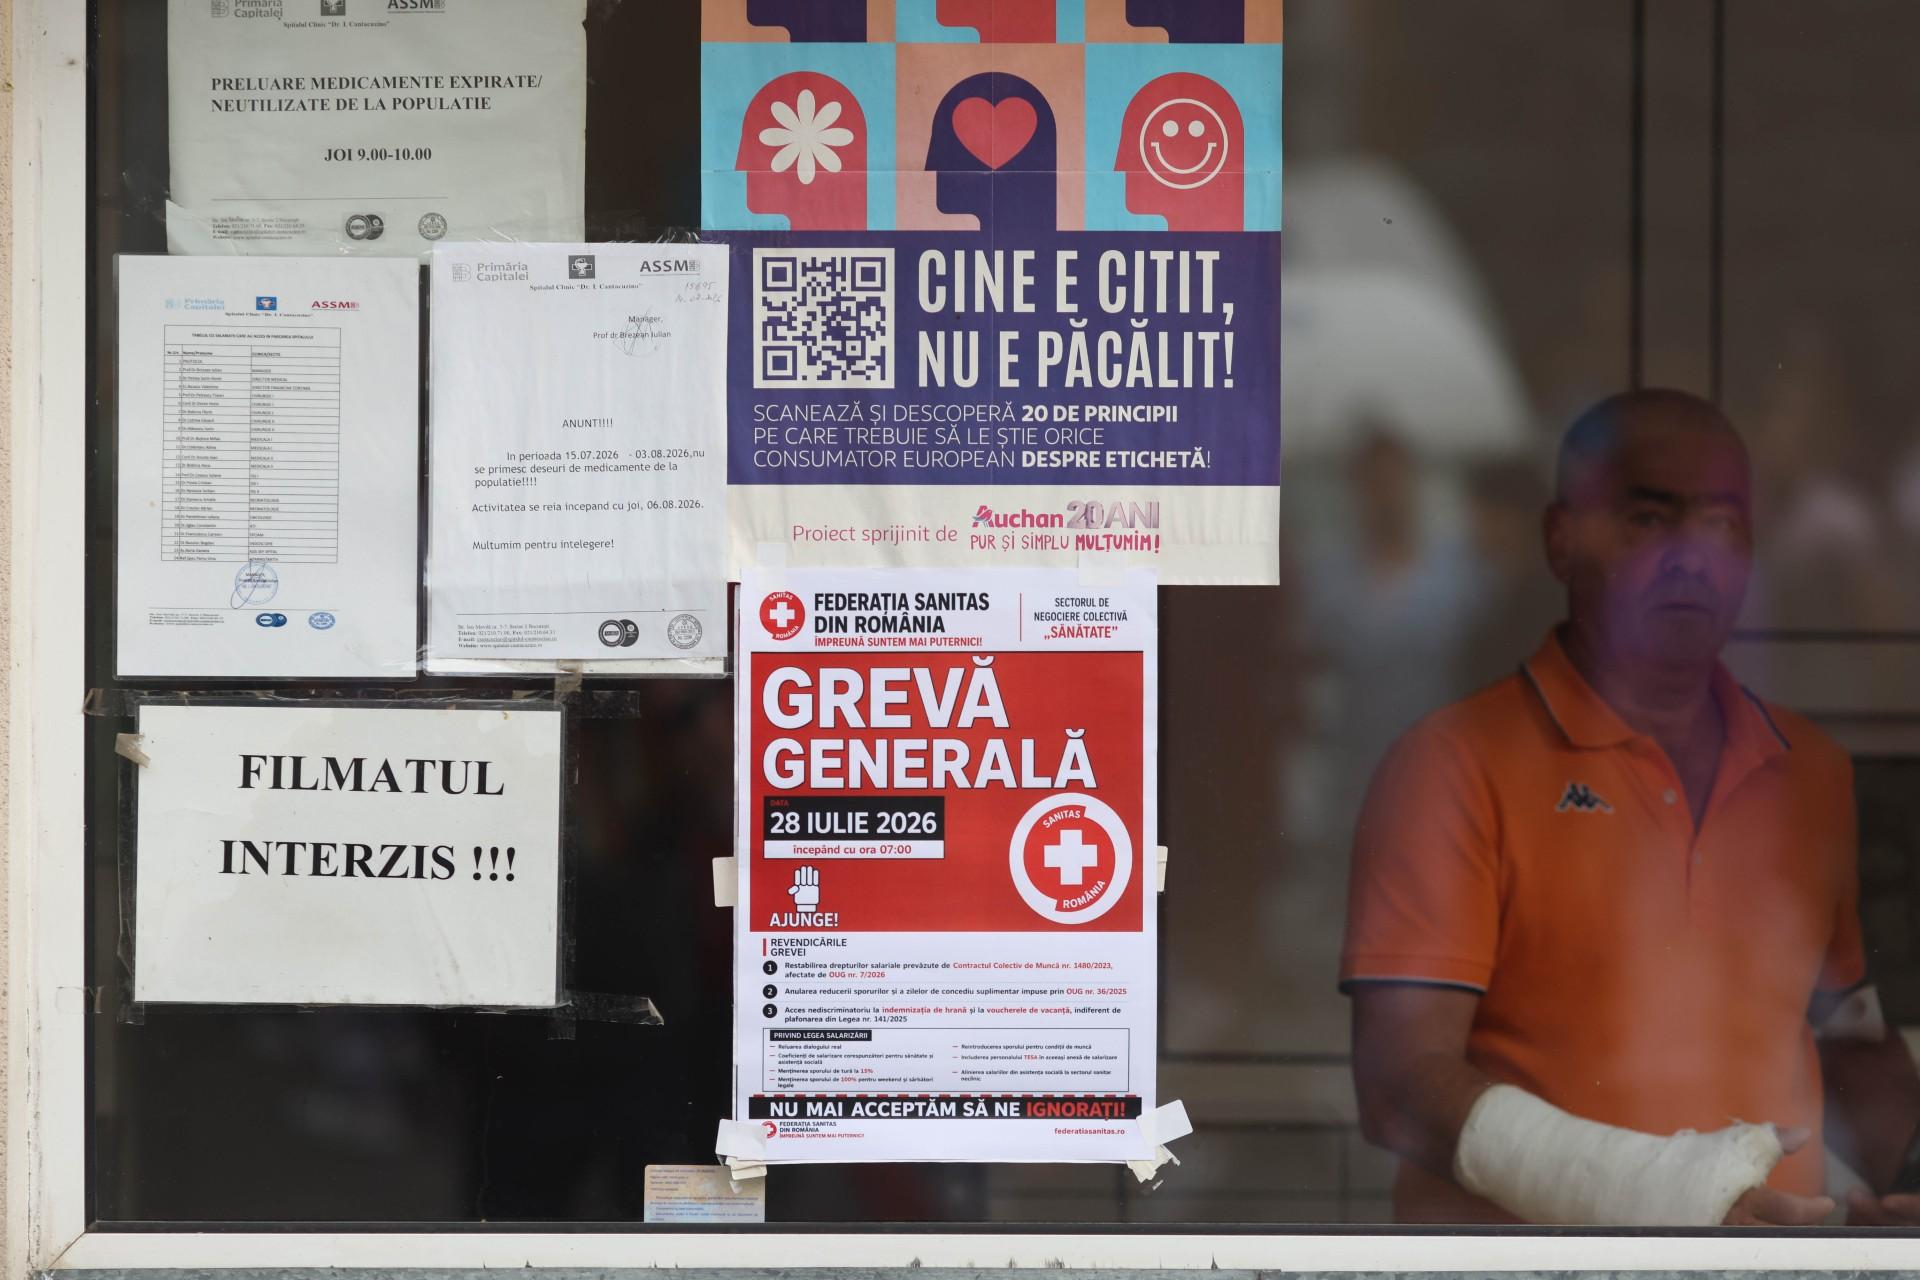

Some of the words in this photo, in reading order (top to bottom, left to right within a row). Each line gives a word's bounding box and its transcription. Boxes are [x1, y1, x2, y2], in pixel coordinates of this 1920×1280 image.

[211, 77, 306, 91] PRELUARE
[311, 75, 444, 90] MEDICAMENTE
[450, 74, 543, 89] EXPIRATE/
[211, 98, 330, 113] NEUTILIZATE
[336, 97, 359, 111] DE
[364, 97, 386, 111] LA
[392, 96, 491, 111] POPULATIE
[324, 148, 352, 162] JOI
[357, 147, 432, 161] 9.00-10.00
[477, 261, 528, 273] Primăria
[476, 270, 529, 282] Capitalei
[918, 249, 1036, 314] CINE
[1056, 250, 1079, 313] E
[1098, 249, 1234, 326] CITIT,
[311, 300, 351, 311] ASSM
[918, 330, 979, 388] NU
[999, 330, 1020, 388] E
[1038, 318, 1234, 389] PĂCĂLIT!
[753, 401, 864, 422] SCANEAZĂ
[870, 404, 886, 426] ȘI
[893, 401, 1016, 423] DESCOPERĂ
[1021, 404, 1049, 422] 20
[1053, 404, 1080, 422] DE
[1084, 404, 1178, 423] PRINCIPII
[562, 417, 613, 428] ANUNT!!!!
[754, 427, 779, 445] PE
[785, 427, 838, 445] CARE
[843, 427, 928, 445] TREBUIE
[935, 424, 961, 445] SĂ
[967, 427, 991, 445] LE
[997, 427, 1038, 449] ȘTIE
[1044, 427, 1105, 445] ORICE
[507, 452, 516, 461] In
[518, 450, 562, 463] perioada
[565, 450, 619, 460] 15.07.2026
[753, 450, 897, 468] CONSUMATOR
[903, 449, 1015, 468] EUROPEAN
[1021, 450, 1101, 468] DESPRE
[1105, 447, 1211, 469] ETICHETĂ!
[474, 466, 486, 474] se
[488, 464, 527, 475] primesc
[529, 463, 566, 474] deseuri
[568, 463, 582, 473] de
[584, 462, 651, 473] medicamente
[653, 461, 666, 472] de
[668, 461, 678, 471] la
[474, 476, 537, 489] populatie!!!!
[471, 503, 526, 513] Activitatea
[528, 504, 540, 512] se
[542, 502, 562, 512] reia
[565, 501, 610, 513] incepand
[612, 503, 624, 511] cu
[626, 501, 644, 512] joi,
[646, 499, 704, 510] 06.08.2026.
[972, 504, 1064, 529] Auchan
[793, 524, 856, 542] Proiect
[862, 524, 930, 547] sprijinit
[935, 524, 958, 542] de
[970, 534, 997, 550] PUR
[1001, 531, 1015, 552] ȘI
[472, 540, 522, 550] Multumim
[524, 540, 558, 552] pentru
[560, 538, 615, 551] intelegere!
[768, 591, 793, 602] SANITAS
[814, 592, 910, 614] FEDERAȚIA
[914, 592, 990, 611] SANITAS
[1054, 597, 1097, 608] SECTORUL
[1098, 597, 1110, 608] DE
[814, 615, 848, 634] DIN
[854, 612, 946, 634] ROMÂNIA
[1033, 611, 1081, 622] NEGOCIERE
[1082, 609, 1128, 622] COLECTIVĂ
[775, 625, 800, 640] ROMÂNIA
[814, 635, 865, 647] ÎMPREUNĂ
[867, 637, 907, 647] SUNTEM
[909, 637, 927, 647] MAI
[929, 636, 983, 647] PUTERNICI!
[762, 654, 1011, 729] GREVĂ
[763, 727, 1098, 790] GENERALĂ
[237, 754, 505, 796] FILMATUL
[770, 811, 801, 834] 28
[807, 811, 869, 834] IULIE
[876, 811, 937, 834] 2026
[1042, 809, 1082, 830] SANITAS
[793, 844, 841, 857] începând
[843, 847, 856, 855] cu
[859, 846, 877, 855] ora
[879, 844, 912, 855] 07:00
[218, 839, 456, 881] INTERZIS
[472, 846, 516, 882] !!!
[1062, 879, 1107, 910] ROMÂNIA
[769, 912, 838, 928] AJUNGE!
[770, 936, 848, 947] REVENDICĂRILE
[770, 947, 806, 957] GREVEI
[784, 961, 828, 969] Restabilirea
[829, 962, 869, 971] drepturilor
[870, 961, 901, 969] salariale
[1073, 962, 1113, 970] 1480/2023,
[784, 971, 816, 979] afectate
[860, 971, 886, 979] 7/2026
[784, 987, 818, 995] Anularea
[819, 987, 852, 995] reducerii
[853, 987, 890, 996] sporurilor
[891, 987, 898, 995] și
[906, 987, 929, 995] zilelor
[941, 987, 975, 995] concediu
[976, 987, 1020, 996] suplimentar
[1021, 988, 1048, 996] impuse
[1049, 988, 1065, 997] prin
[1066, 987, 1084, 995] OUG
[1096, 988, 1127, 996] 36/2025
[826, 1031, 868, 1039] SALARIZĂRII
[770, 1101, 798, 1117] NU
[806, 1101, 843, 1117] MAI
[850, 1098, 957, 1117] ACCEPTĂM
[962, 1098, 989, 1118] SĂ
[994, 1101, 1021, 1117] NE
[1026, 1101, 1125, 1122] IGNORAȚI!
[1054, 1127, 1126, 1135] federatiasanitas.ro
